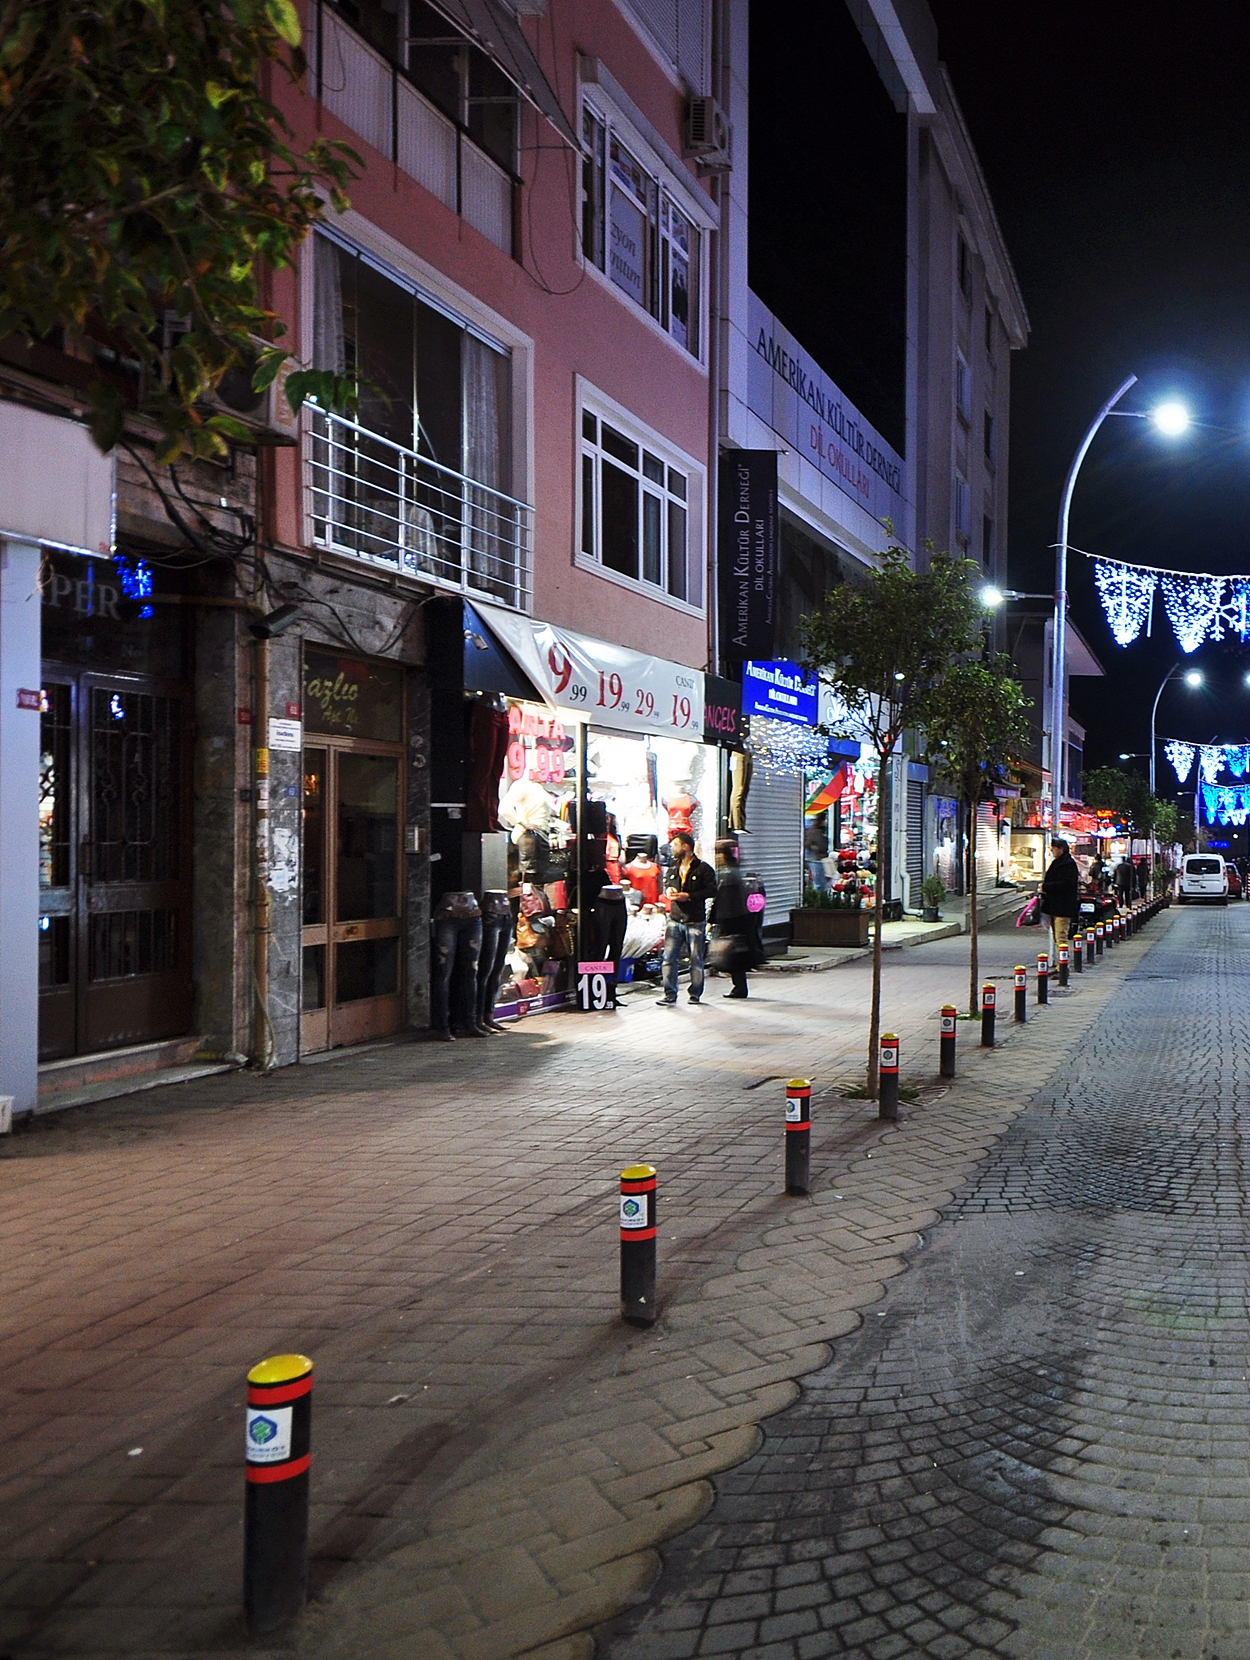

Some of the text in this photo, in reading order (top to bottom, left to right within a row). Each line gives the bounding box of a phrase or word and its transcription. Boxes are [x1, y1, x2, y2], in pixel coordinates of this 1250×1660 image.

[757, 327, 900, 494] AMERİKAN KÜLTÜR DERNEĞİ
[810, 424, 870, 498] DİL OKULLARI
[733, 529, 749, 577] KÜLTÜR
[754, 519, 765, 591] DİL OKULLARI
[732, 580, 749, 647] AMERİKAN
[508, 705, 567, 741] ANTA
